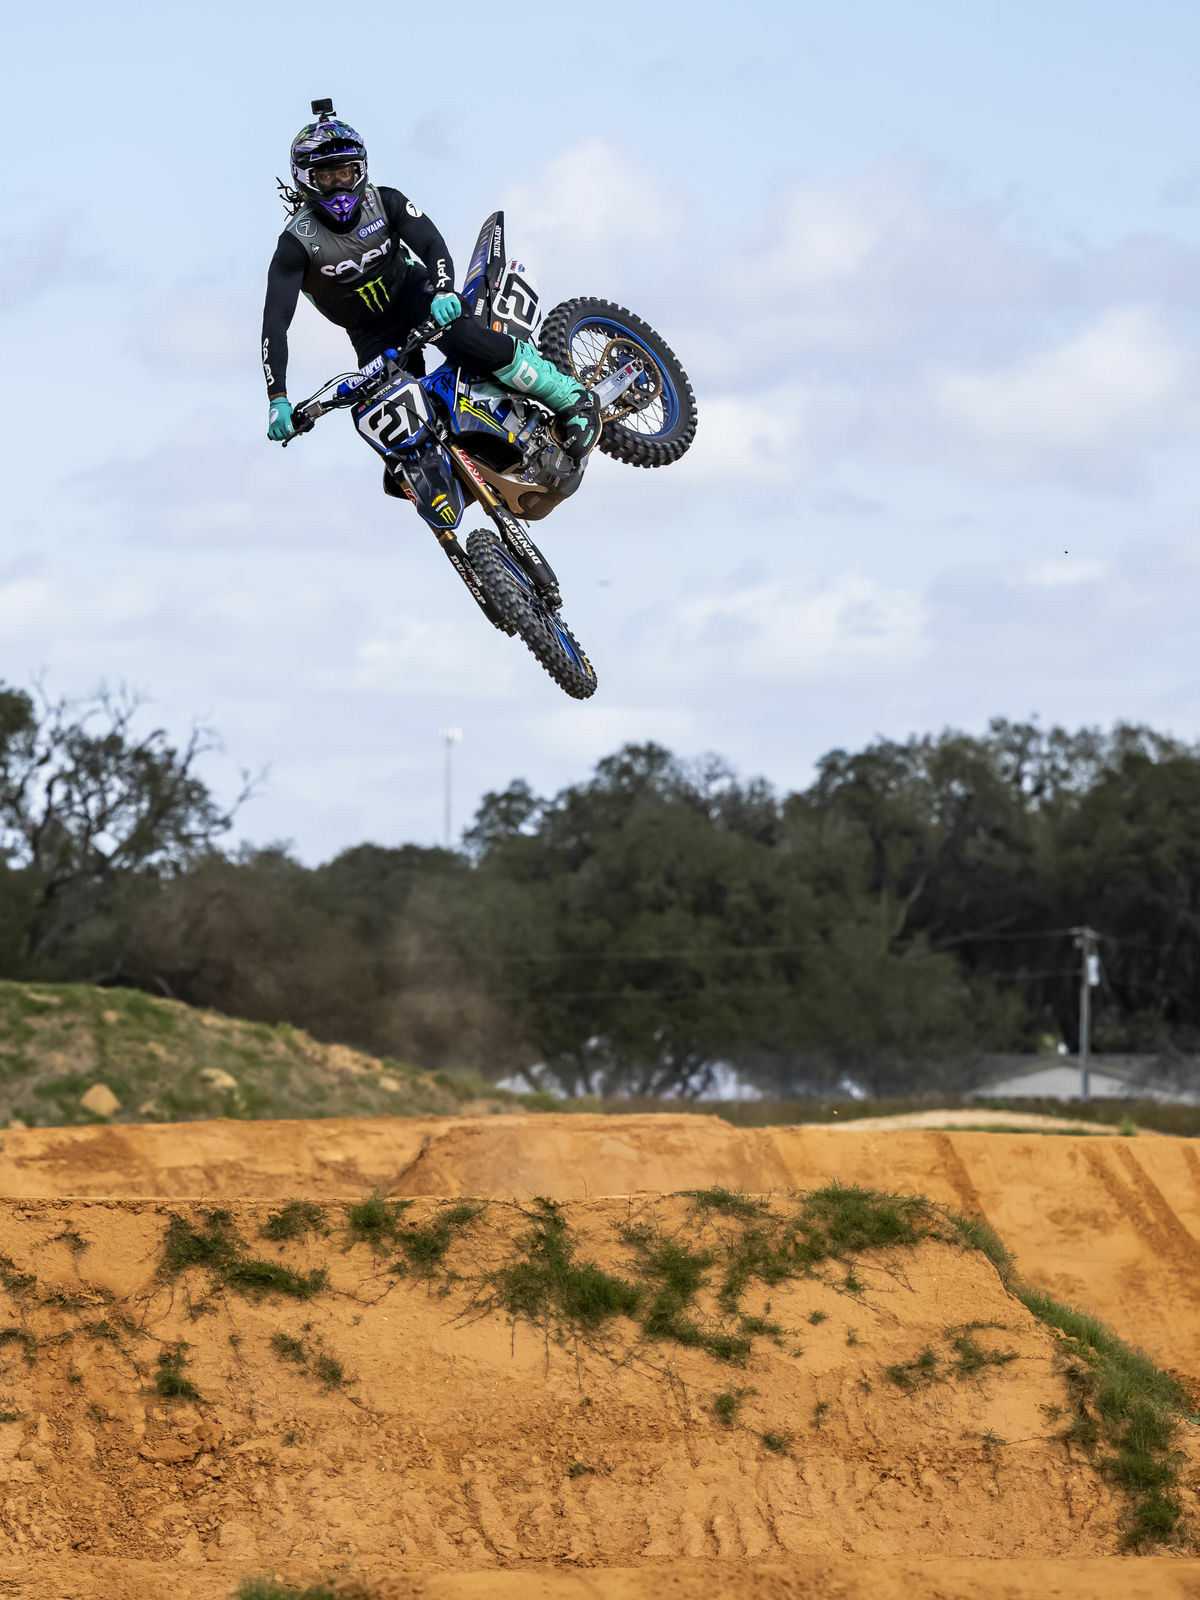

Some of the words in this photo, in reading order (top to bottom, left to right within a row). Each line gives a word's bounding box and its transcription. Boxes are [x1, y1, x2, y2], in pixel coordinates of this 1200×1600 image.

[493, 225, 502, 258] DUNLOP
[502, 516, 543, 566] DUNLOP
[450, 555, 487, 605] DUNLOP
[469, 568, 484, 587] CYCRA
